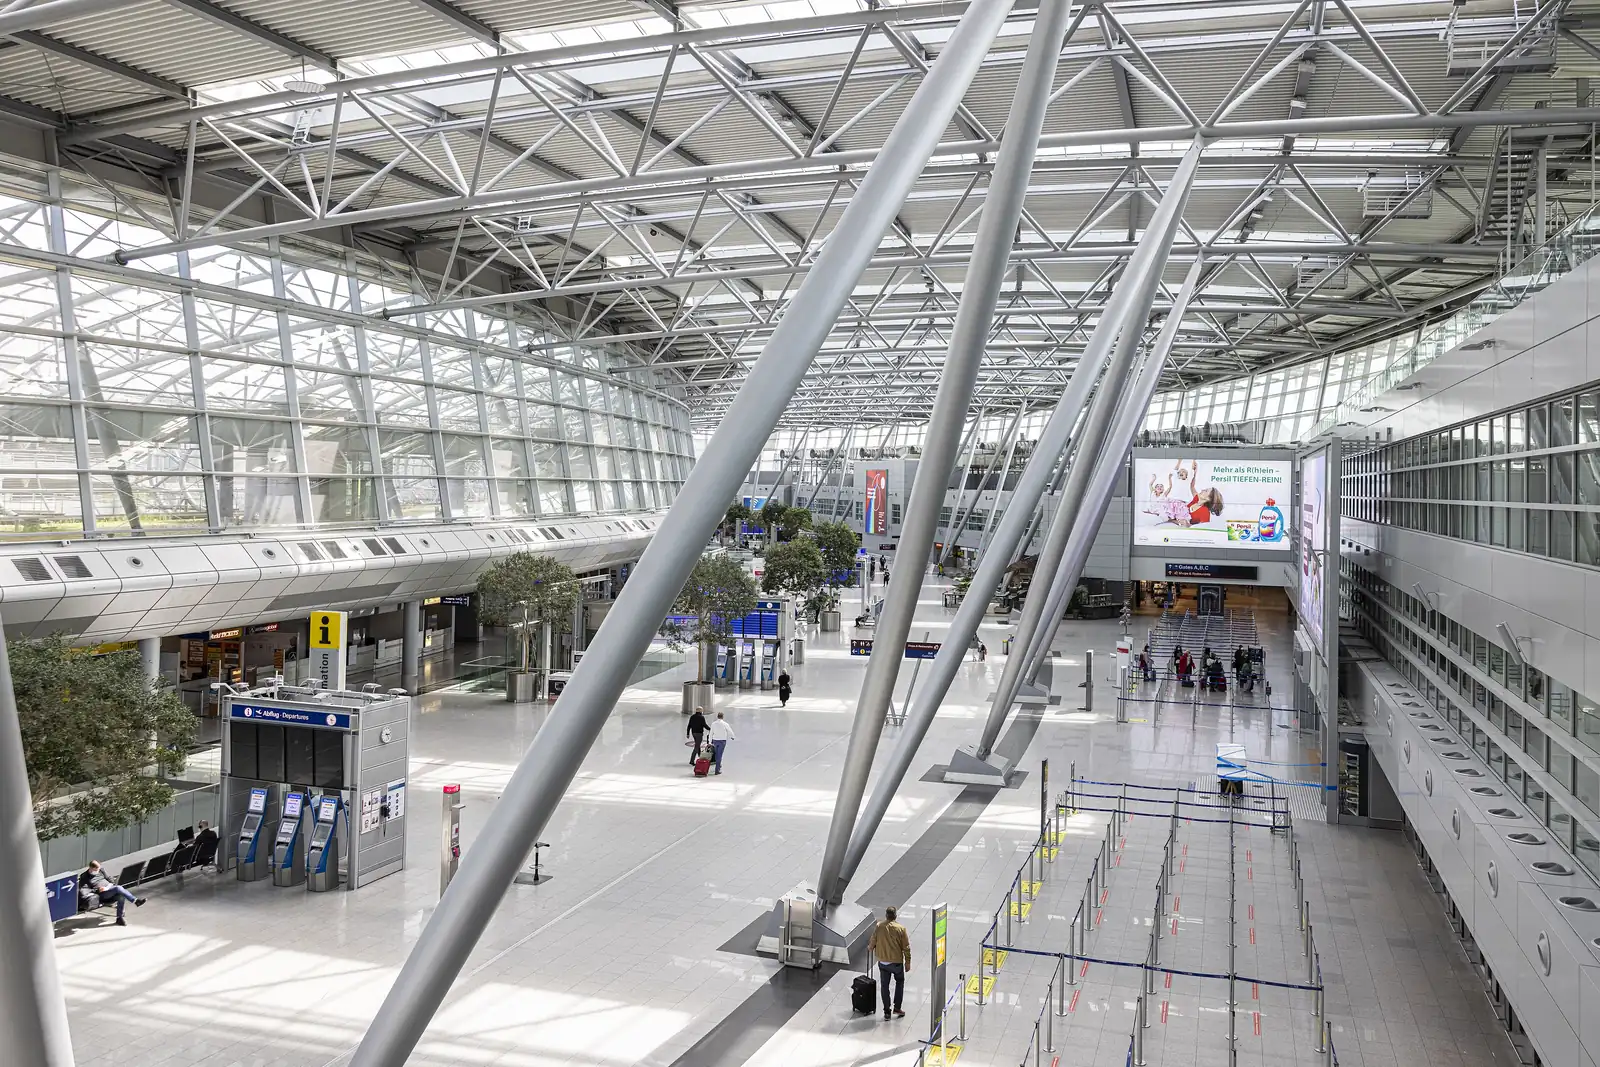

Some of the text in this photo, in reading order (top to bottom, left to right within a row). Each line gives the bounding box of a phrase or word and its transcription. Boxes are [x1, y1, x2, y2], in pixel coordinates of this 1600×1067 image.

[1246, 466, 1274, 474] R(h)ein
[1232, 475, 1282, 483] TIEFEN-REIN!
[263, 710, 279, 719] Abflug
[282, 712, 309, 721] Departures
